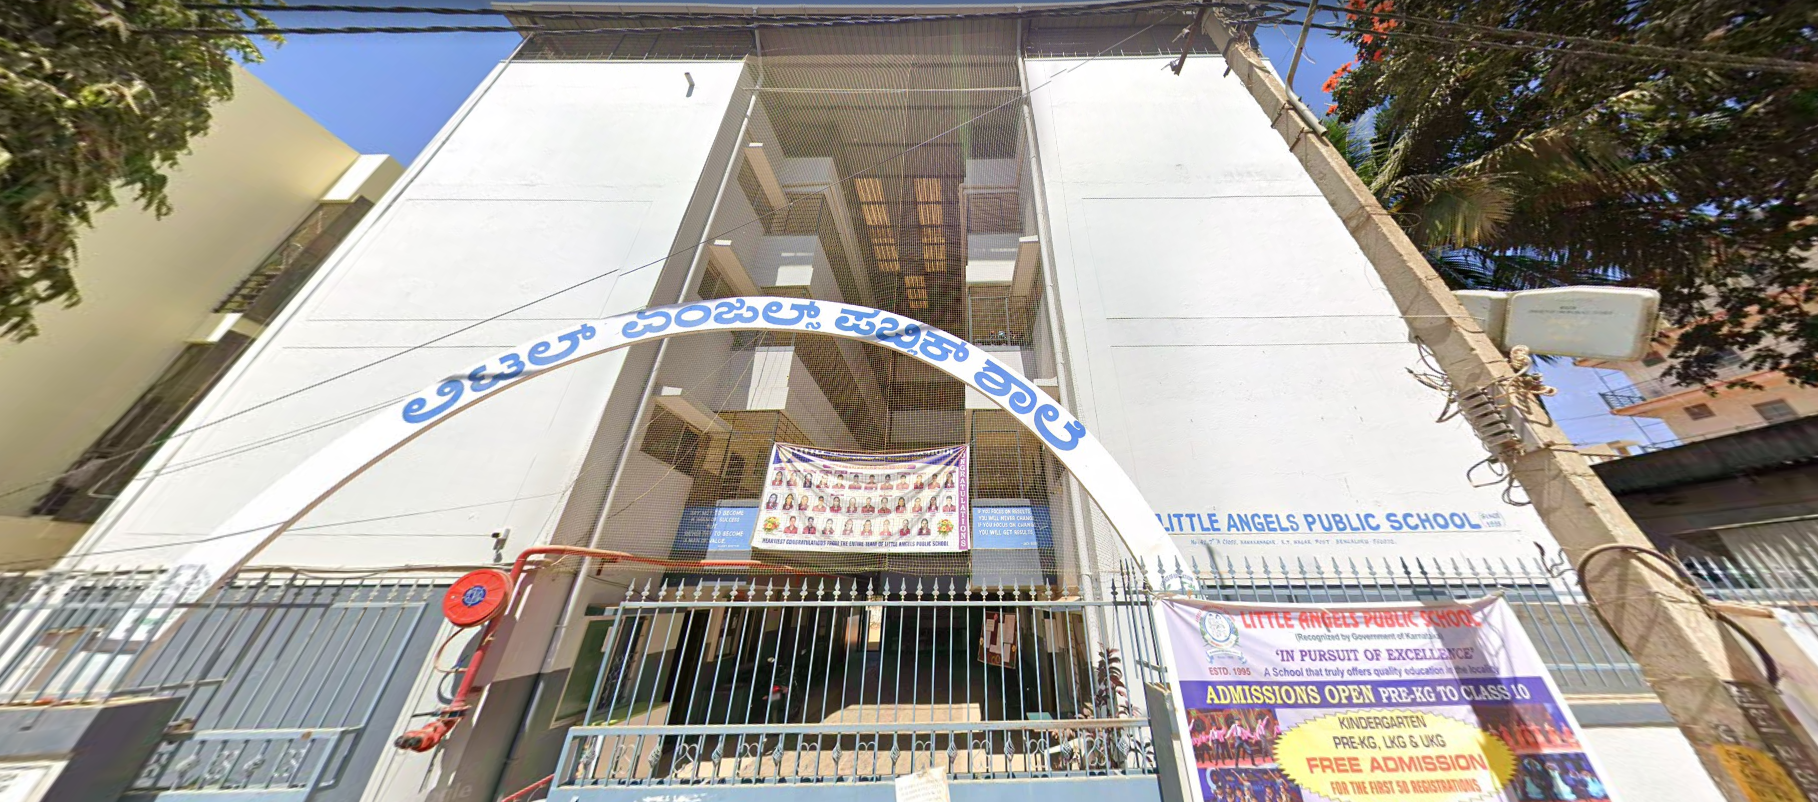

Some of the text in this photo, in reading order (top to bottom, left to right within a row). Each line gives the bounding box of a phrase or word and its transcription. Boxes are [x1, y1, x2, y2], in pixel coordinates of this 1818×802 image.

[974, 358, 1087, 451] ಶಾಲೆ
[959, 450, 967, 547] ONGRATULATIONS
[1227, 513, 1299, 532] ANGELS
[1303, 513, 1381, 532] PUBLIC
[1385, 512, 1482, 530] SCHOOL
[1240, 611, 1294, 629] LITTLE
[1298, 611, 1359, 630] ANGELS
[1362, 610, 1419, 629] PUBLIC
[1420, 609, 1482, 628] SCHOOL
[1295, 633, 1340, 642] (Recognized
[1341, 633, 1351, 642] by
[1397, 632, 1404, 640] of
[1299, 649, 1359, 662] PURSUIT
[1364, 648, 1383, 661] OF
[1208, 667, 1251, 676] ESTD. 1995
[1264, 664, 1500, 678] A School that truly offers quality education in the locality
[1206, 683, 1532, 705] ADMISSIONS OPEN PRE-KG TO CLASS 10
[1338, 715, 1427, 730] KINDERGARTEN
[1332, 734, 1447, 751] PRE-KG, LKG & UKG
[1306, 754, 1488, 774] FREE ADMISSION
[1330, 778, 1482, 795] FOR THE FIRST 50 REGISTRATIONS
